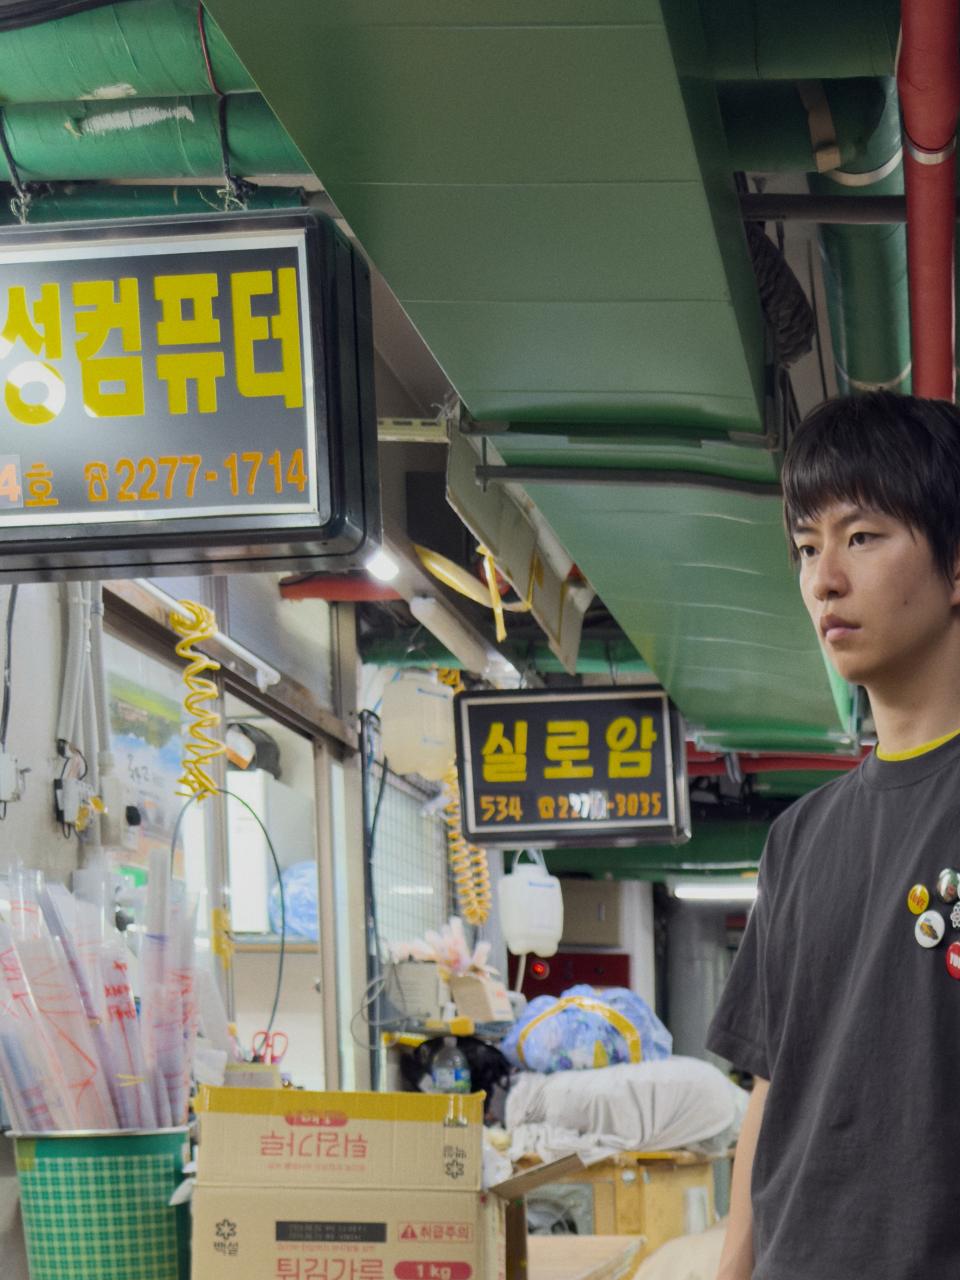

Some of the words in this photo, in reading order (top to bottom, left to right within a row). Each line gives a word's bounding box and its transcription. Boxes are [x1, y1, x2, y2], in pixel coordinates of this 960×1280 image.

[1, 267, 304, 425] 성컴퓨터
[115, 448, 308, 502] 2277-1714
[482, 716, 657, 782] 실로암
[480, 795, 523, 821] 534
[430, 1264, 452, 1280] kg
